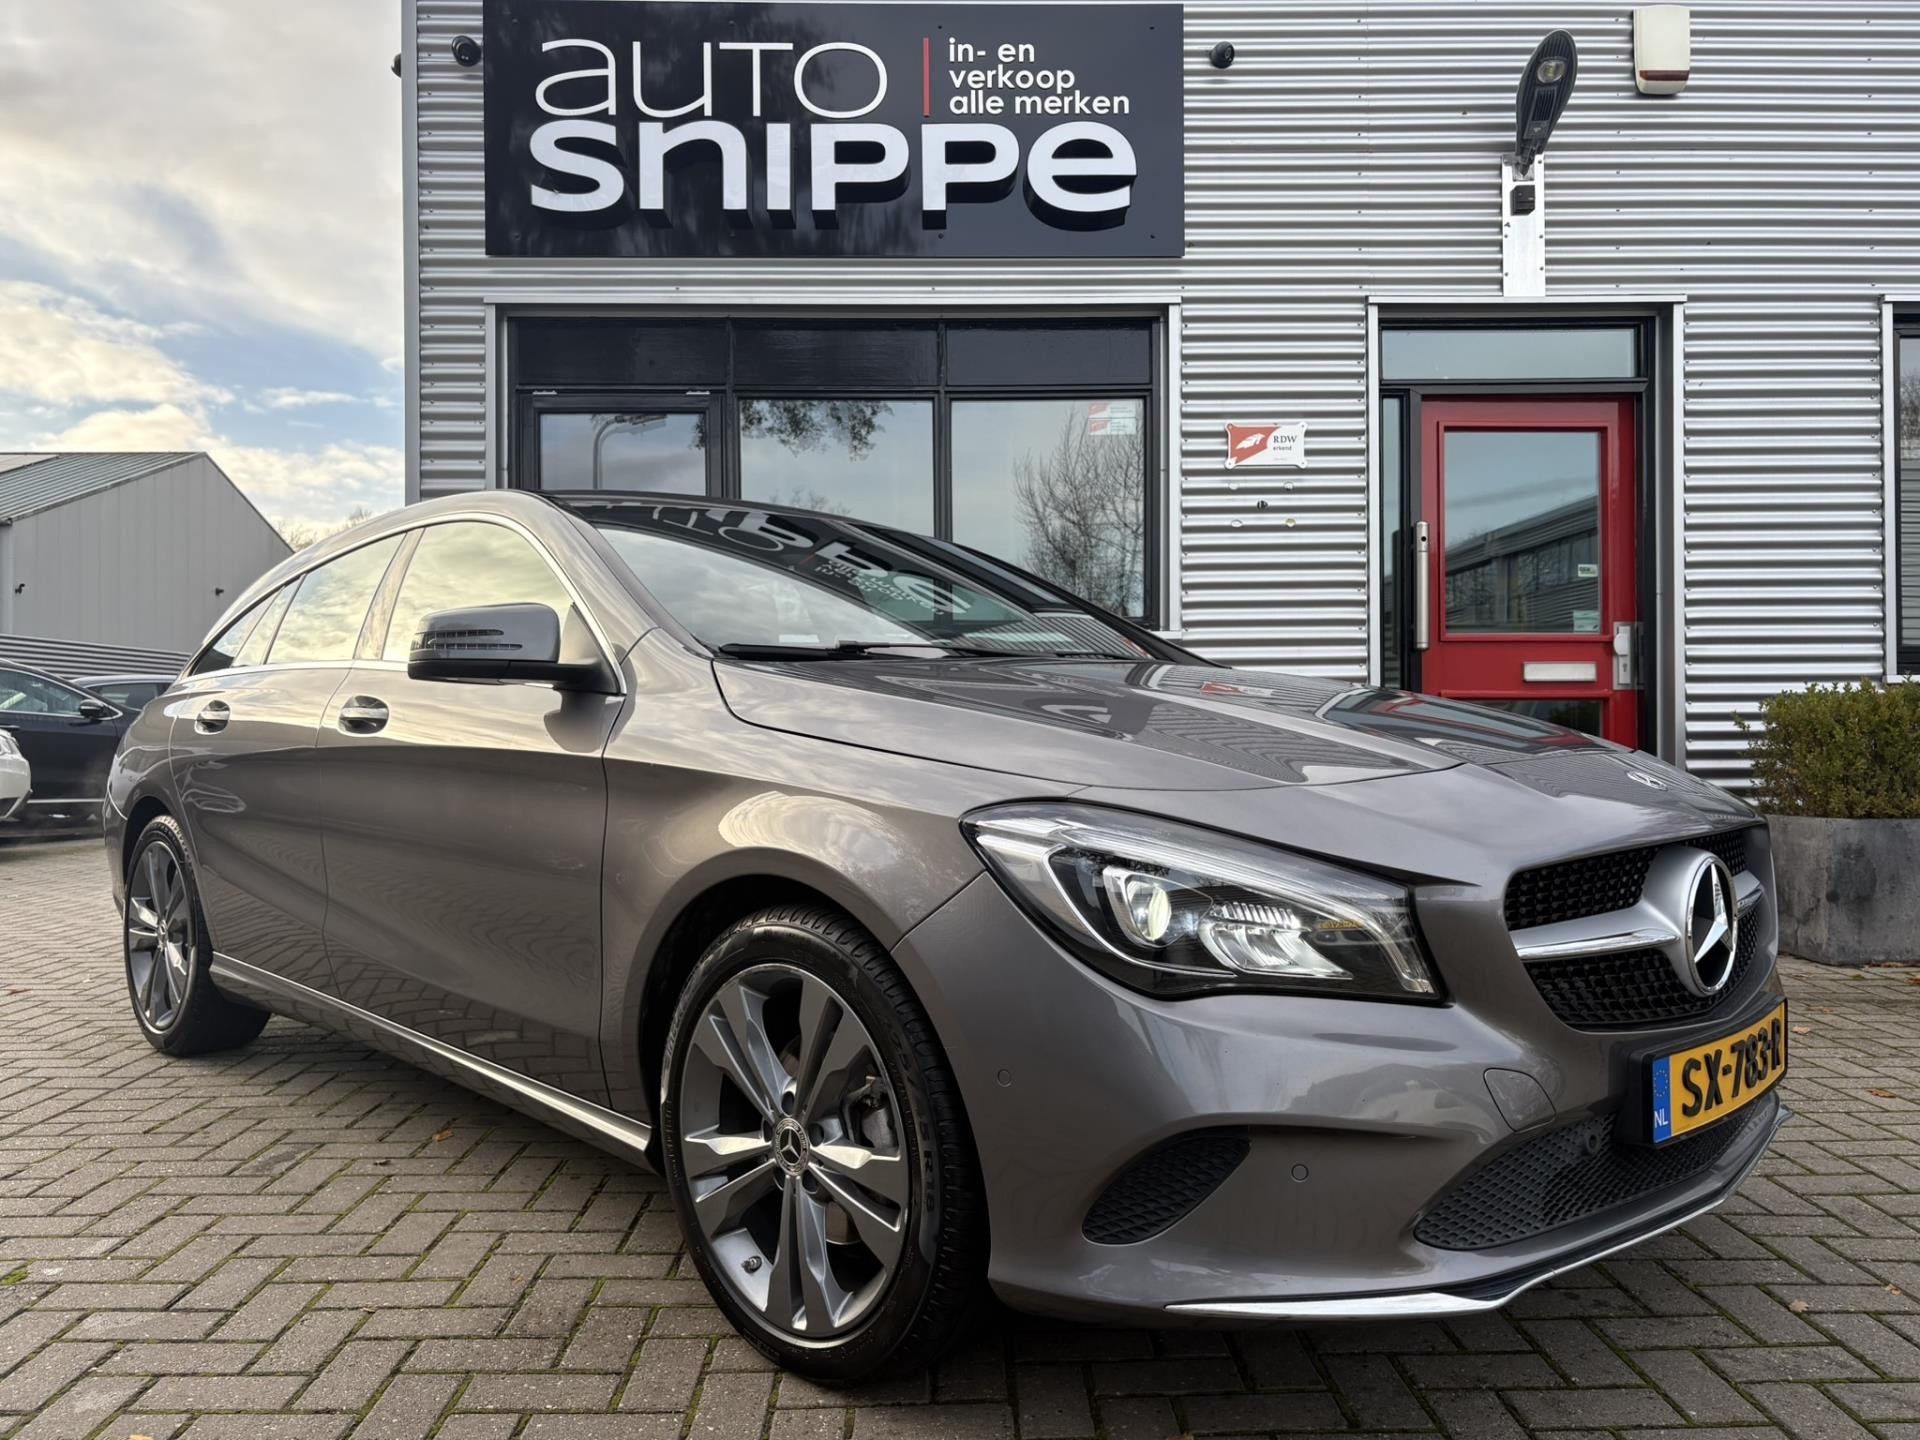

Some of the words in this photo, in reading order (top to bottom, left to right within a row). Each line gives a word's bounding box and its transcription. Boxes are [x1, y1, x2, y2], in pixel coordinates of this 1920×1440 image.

[949, 37, 986, 62] in-
[998, 44, 1035, 62] en
[949, 64, 1075, 94] verkoop
[950, 90, 1004, 115] alle
[1015, 90, 1130, 115] merken
[1273, 435, 1297, 443] RDW
[1681, 1018, 1782, 1117] SX-783-R
[1654, 1108, 1669, 1129] NL
